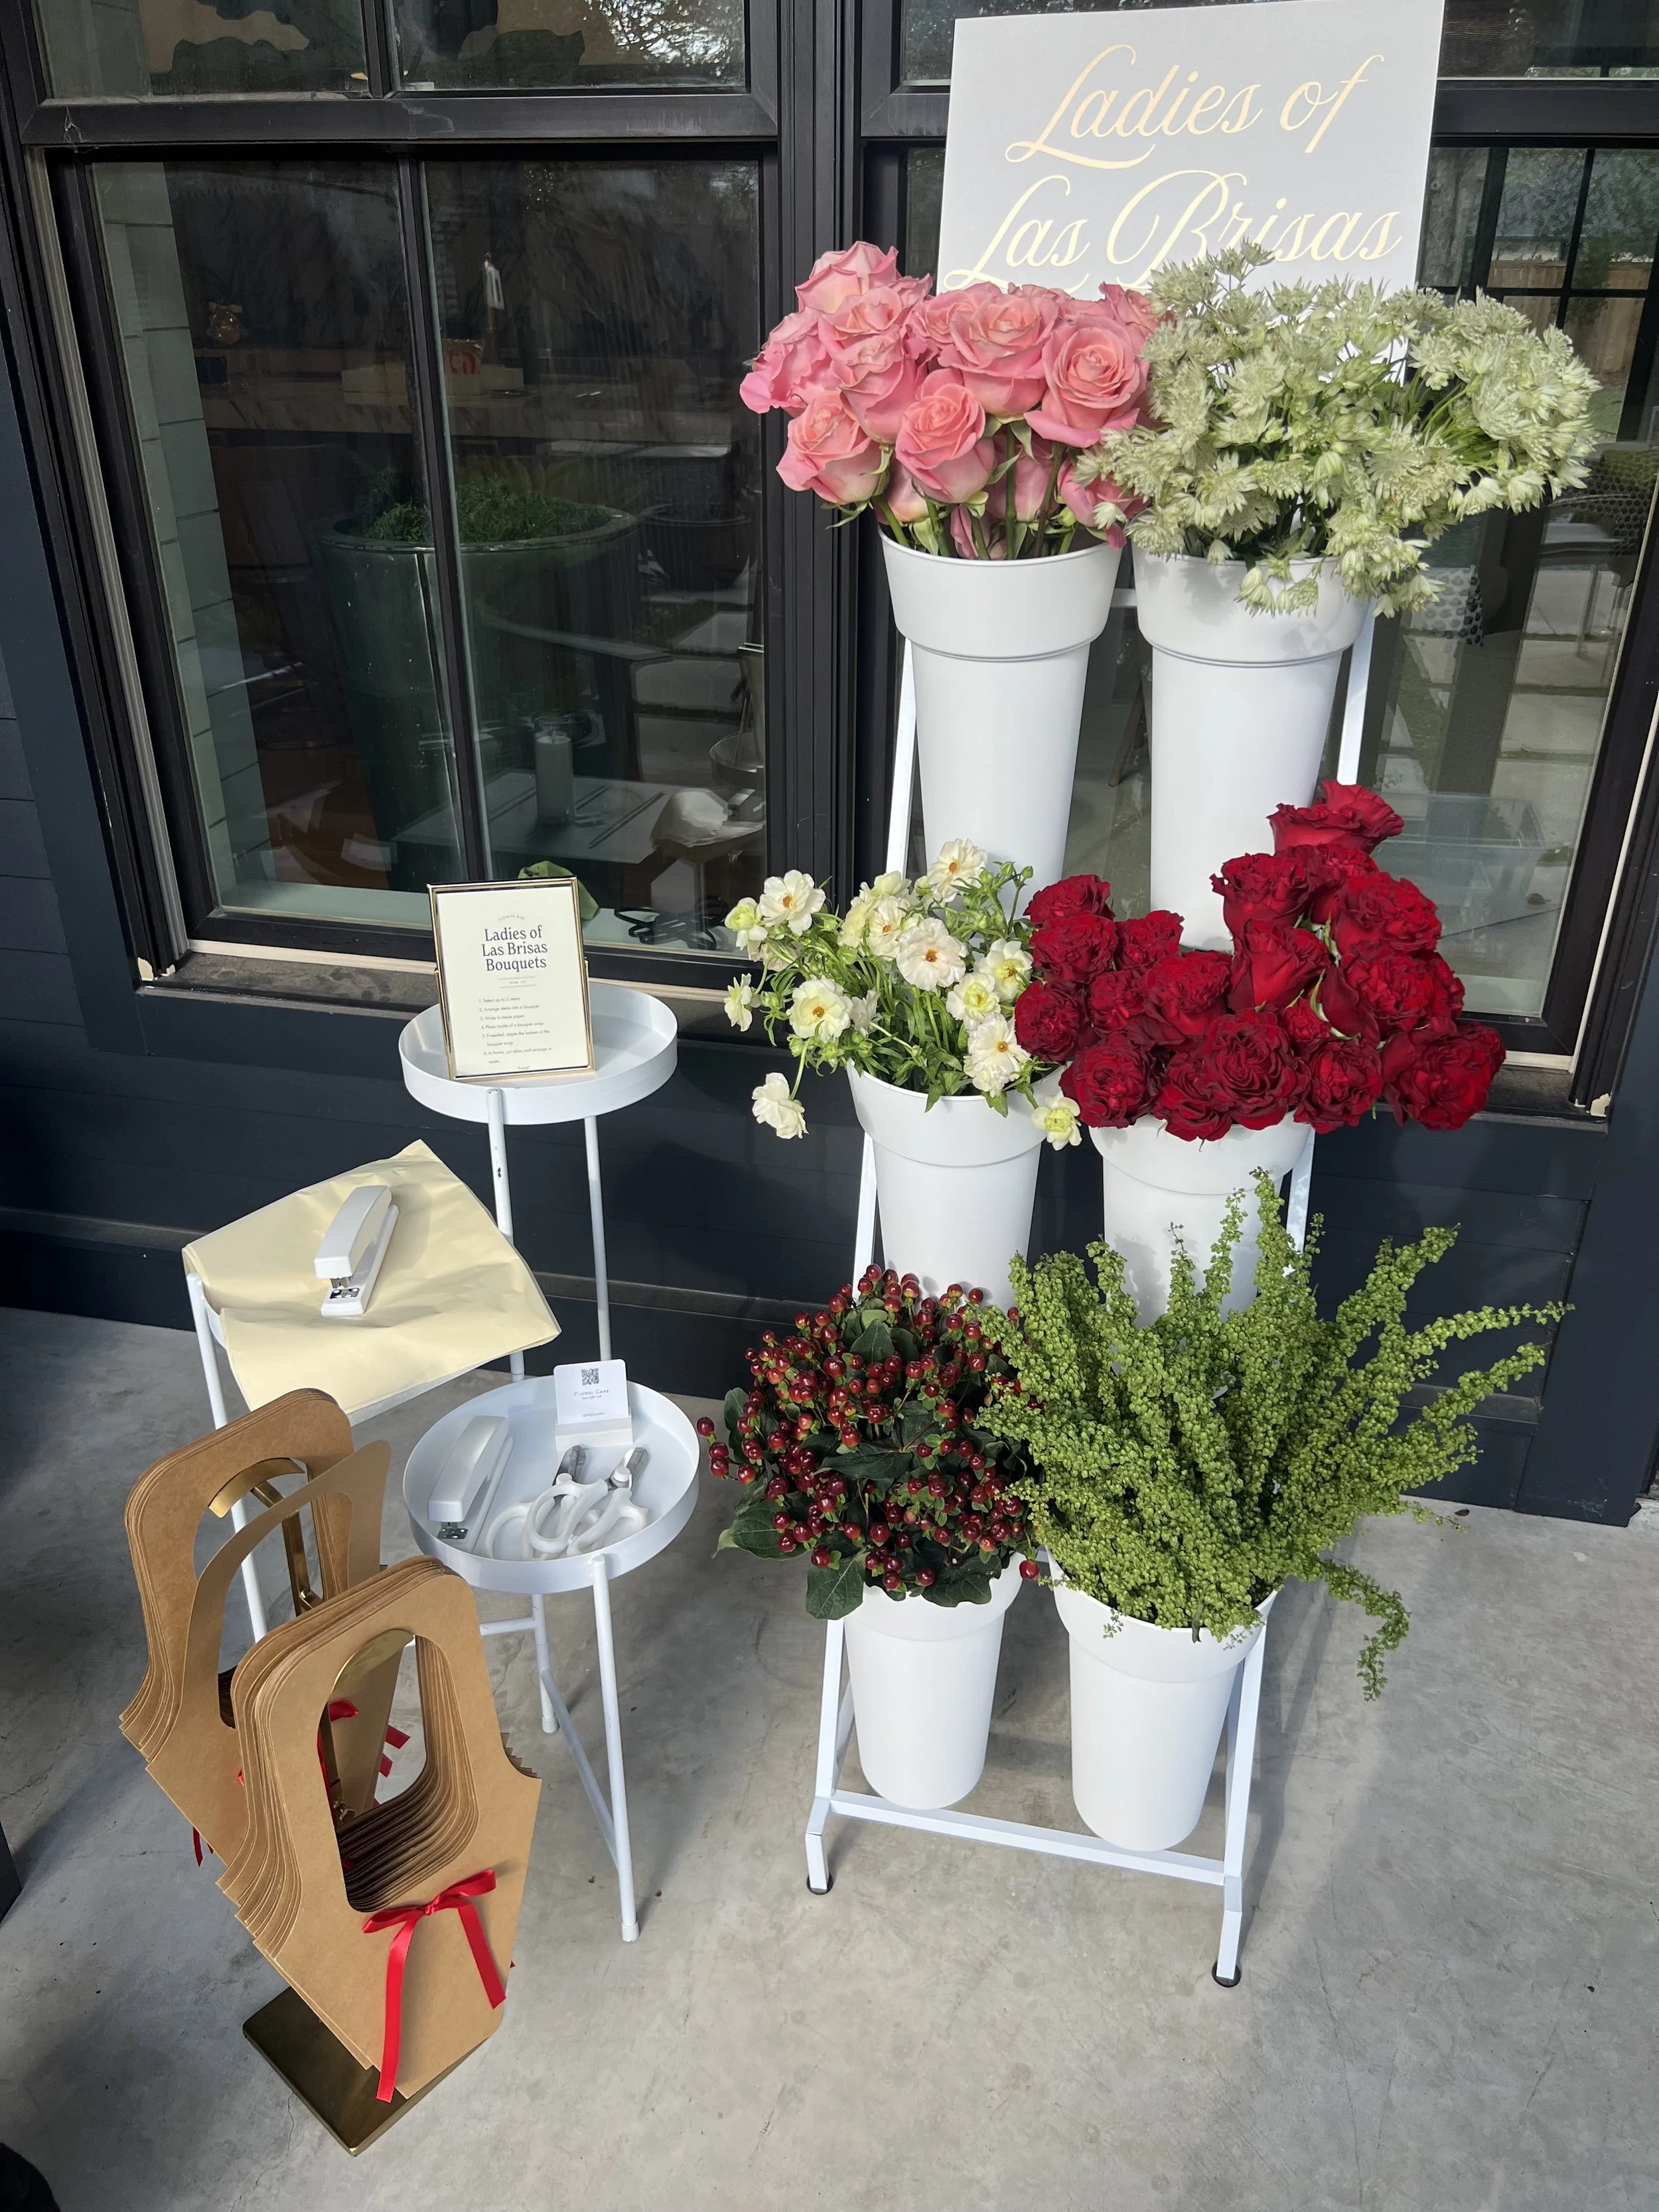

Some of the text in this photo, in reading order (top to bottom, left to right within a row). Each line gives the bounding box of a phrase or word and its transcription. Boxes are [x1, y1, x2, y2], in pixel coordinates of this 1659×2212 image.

[1005, 44, 1385, 169] Ladies of
[942, 169, 1404, 295] Las Brisas
[484, 924, 542, 941] Ladies of
[482, 941, 547, 956] Las Brisas
[486, 956, 547, 972] Bouquets
